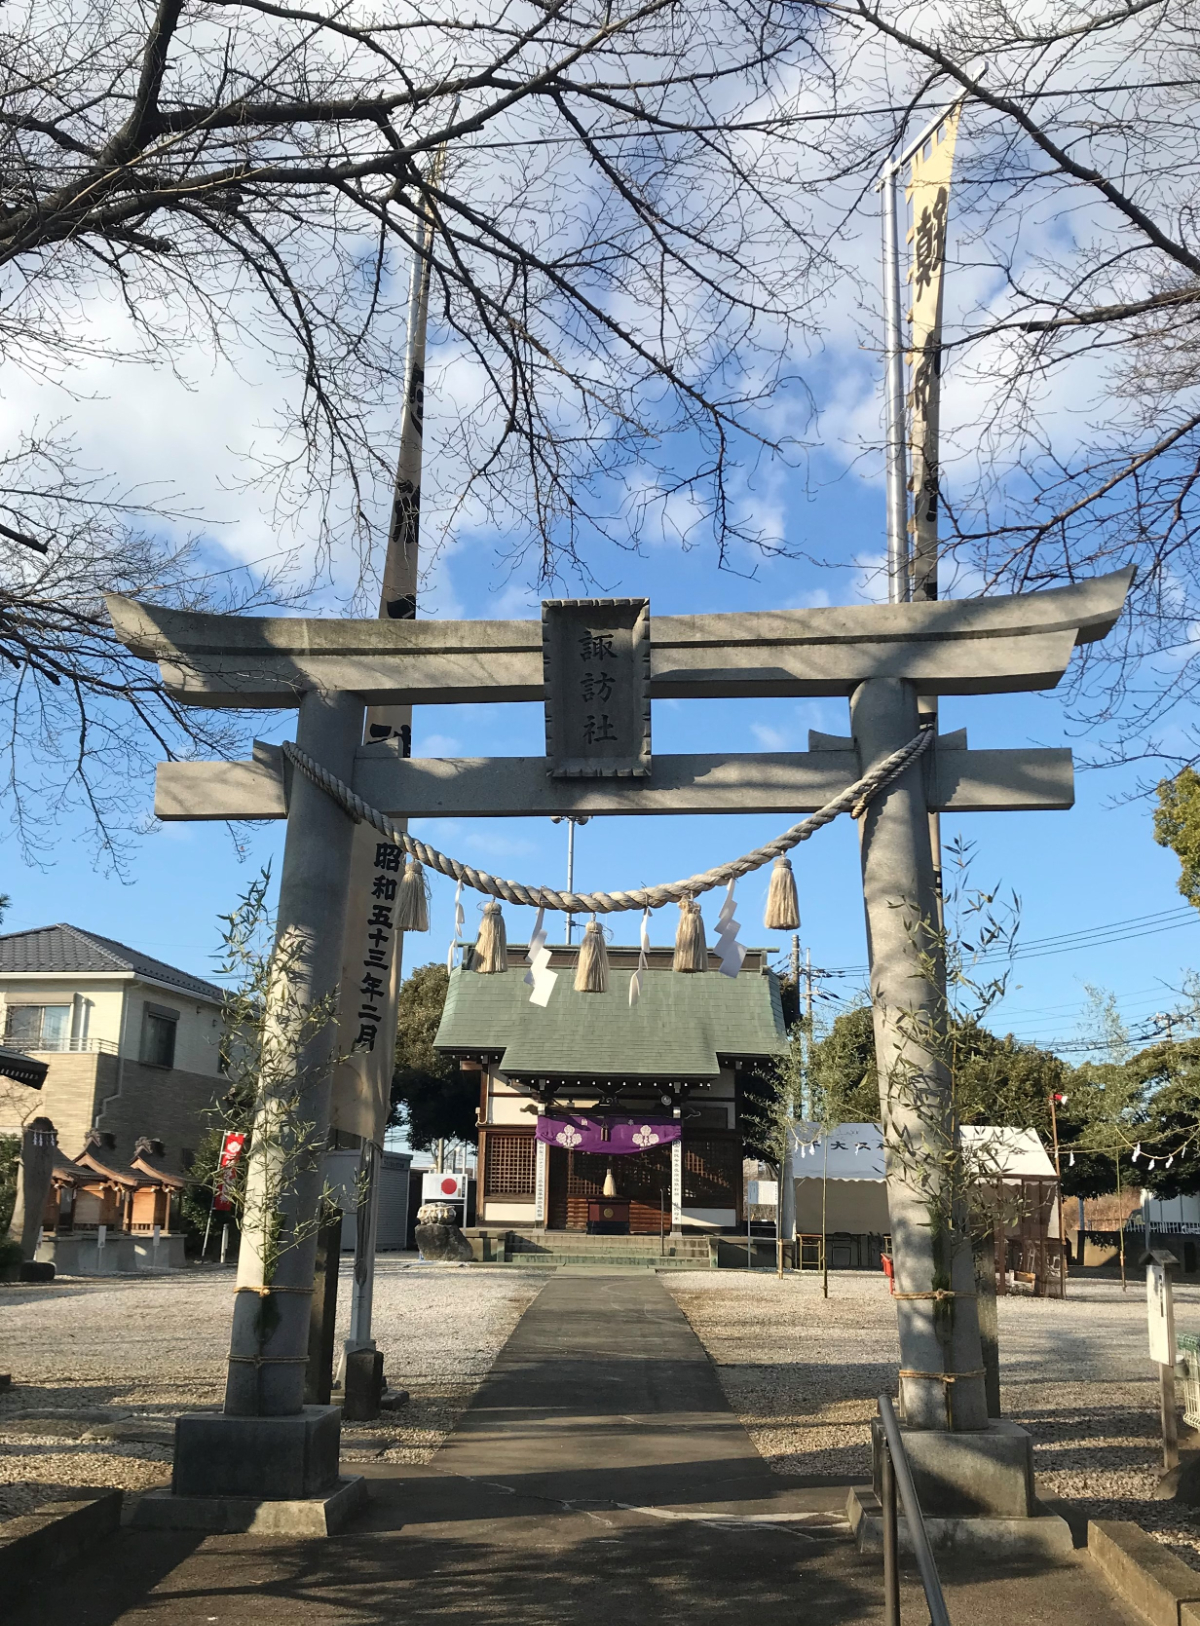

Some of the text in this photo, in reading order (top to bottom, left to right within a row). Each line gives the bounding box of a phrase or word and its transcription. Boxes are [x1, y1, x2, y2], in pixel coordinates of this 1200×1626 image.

[578, 630, 618, 745] 諏訪社
[351, 842, 403, 1052] 昭和五十三年二月
